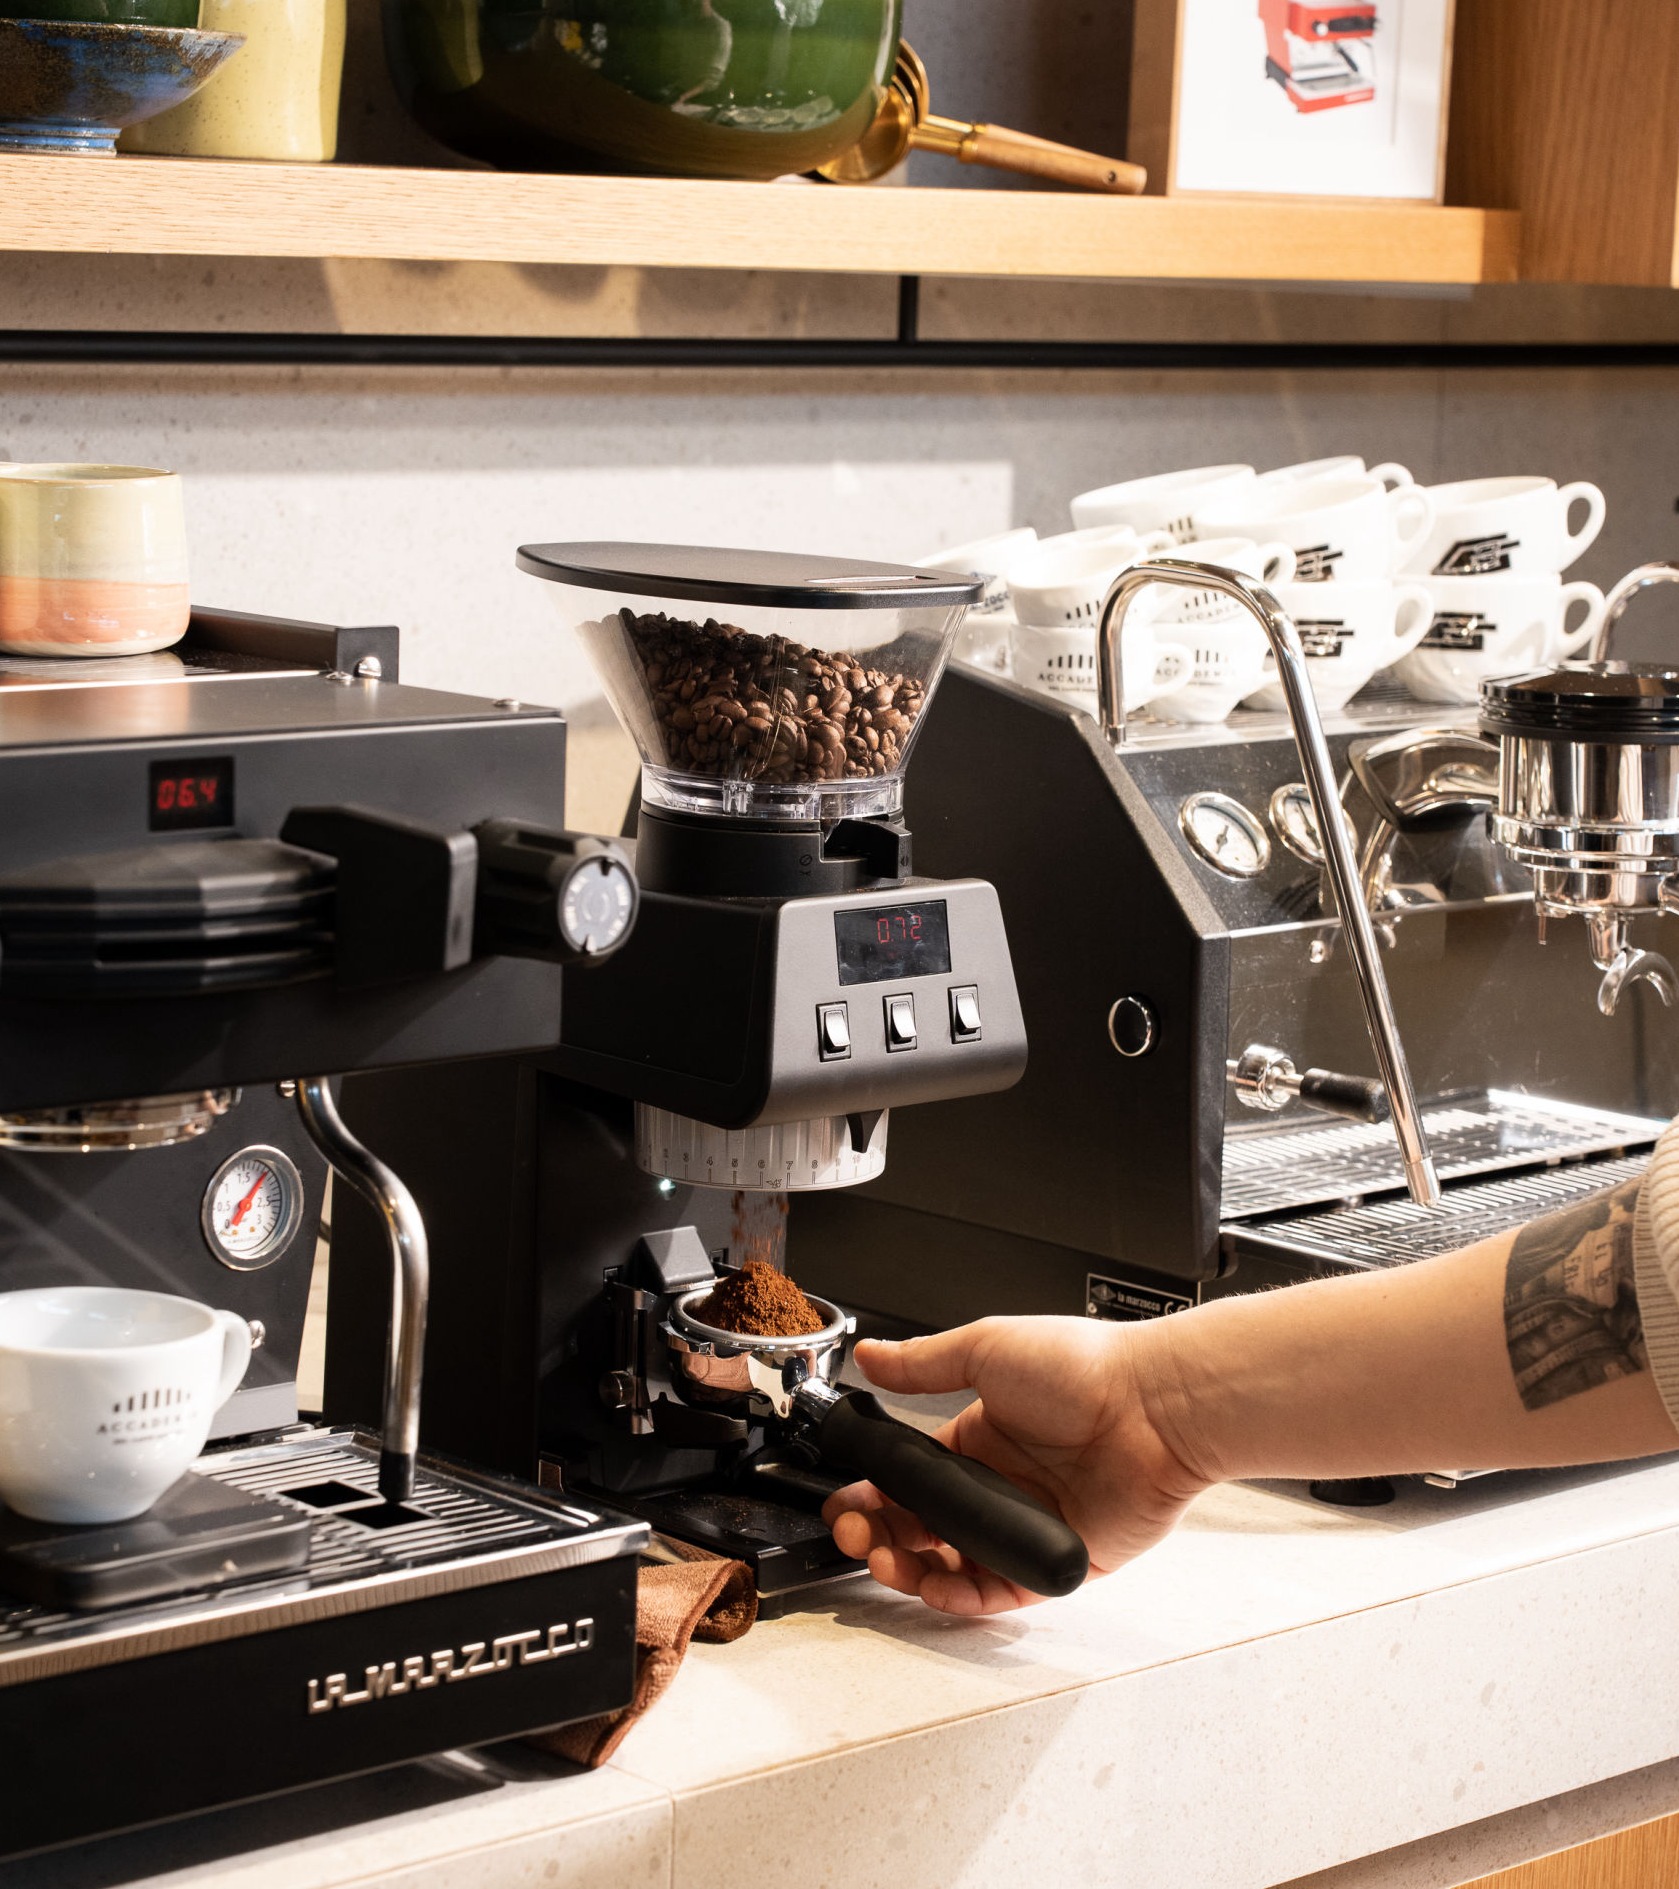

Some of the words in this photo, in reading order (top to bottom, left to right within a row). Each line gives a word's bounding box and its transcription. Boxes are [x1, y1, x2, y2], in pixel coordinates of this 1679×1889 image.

[877, 915, 922, 943] 0.72
[785, 1160, 794, 1171] 7
[811, 1160, 819, 1170] 8
[365, 1617, 595, 1700] MARZOCCO
